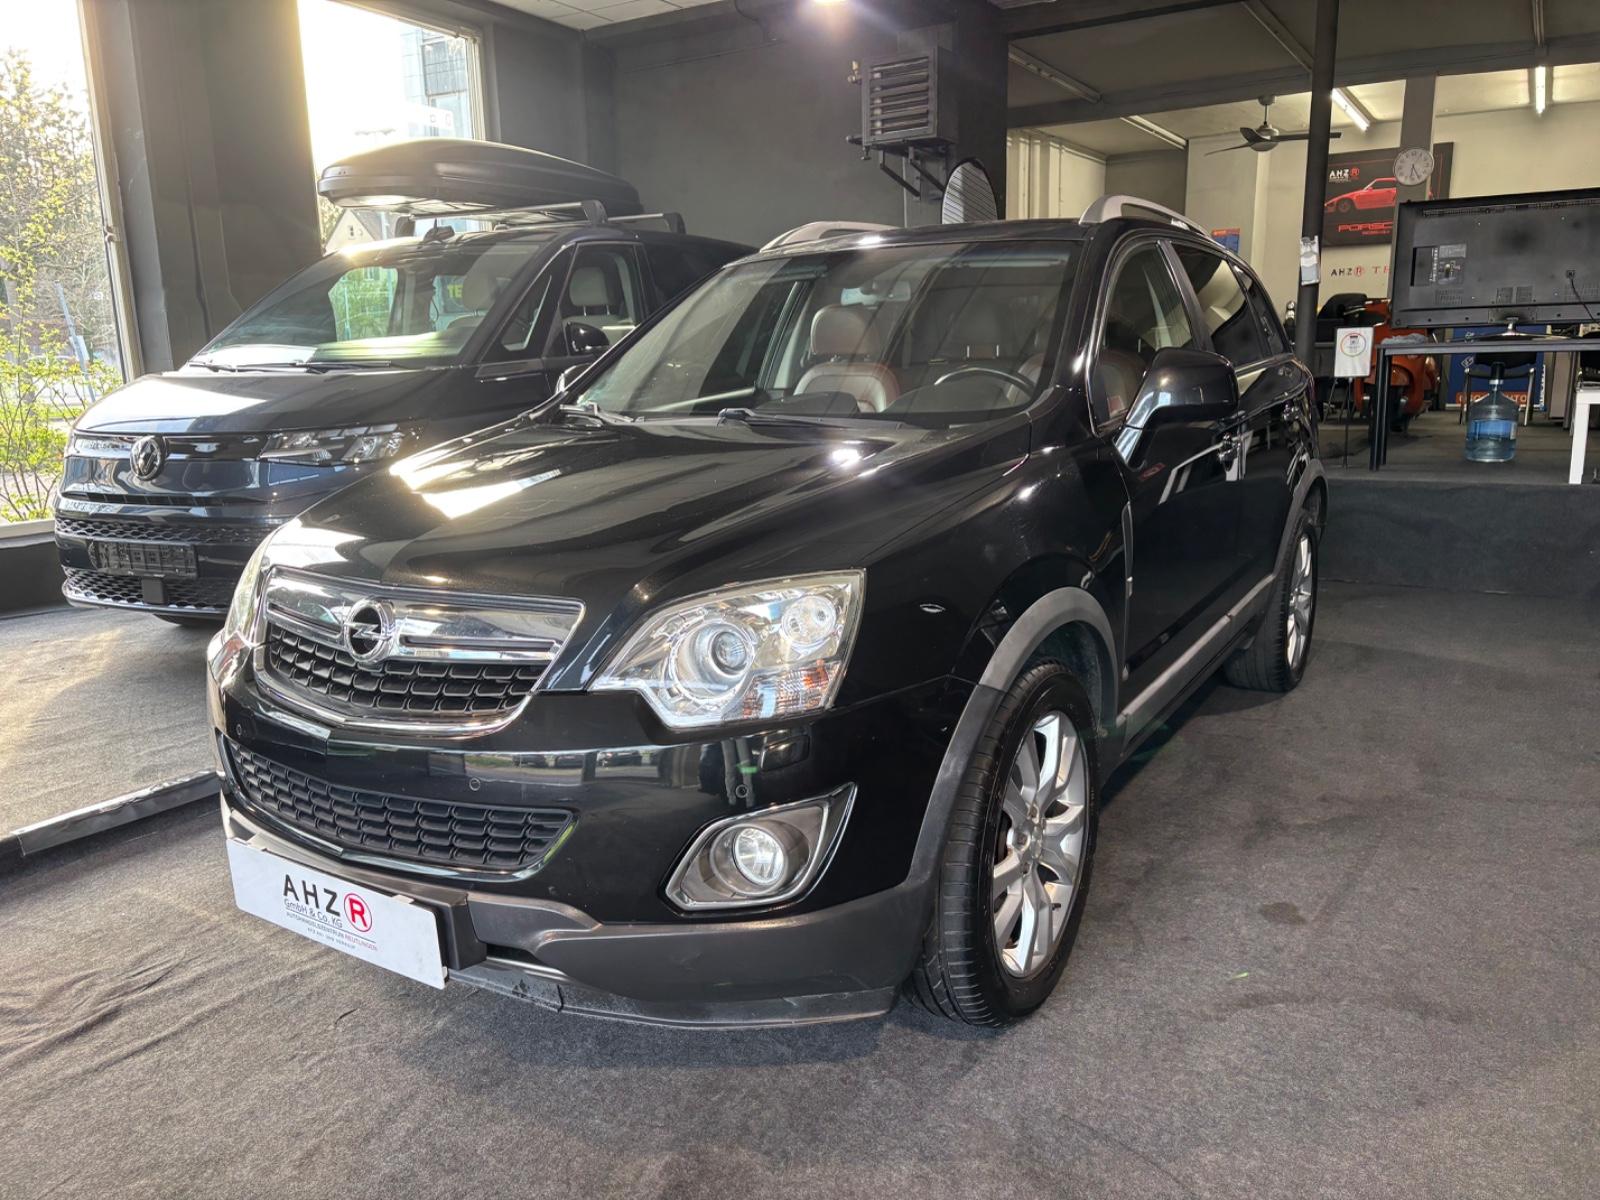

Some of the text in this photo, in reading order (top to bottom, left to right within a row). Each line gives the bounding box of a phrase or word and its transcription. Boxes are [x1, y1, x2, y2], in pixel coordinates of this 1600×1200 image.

[1329, 168, 1349, 178] AHZ
[1338, 222, 1392, 232] PORSC
[1331, 266, 1352, 277] AHZ
[283, 874, 341, 917] AHZ
[284, 898, 308, 915] GmbH
[309, 908, 316, 918] &
